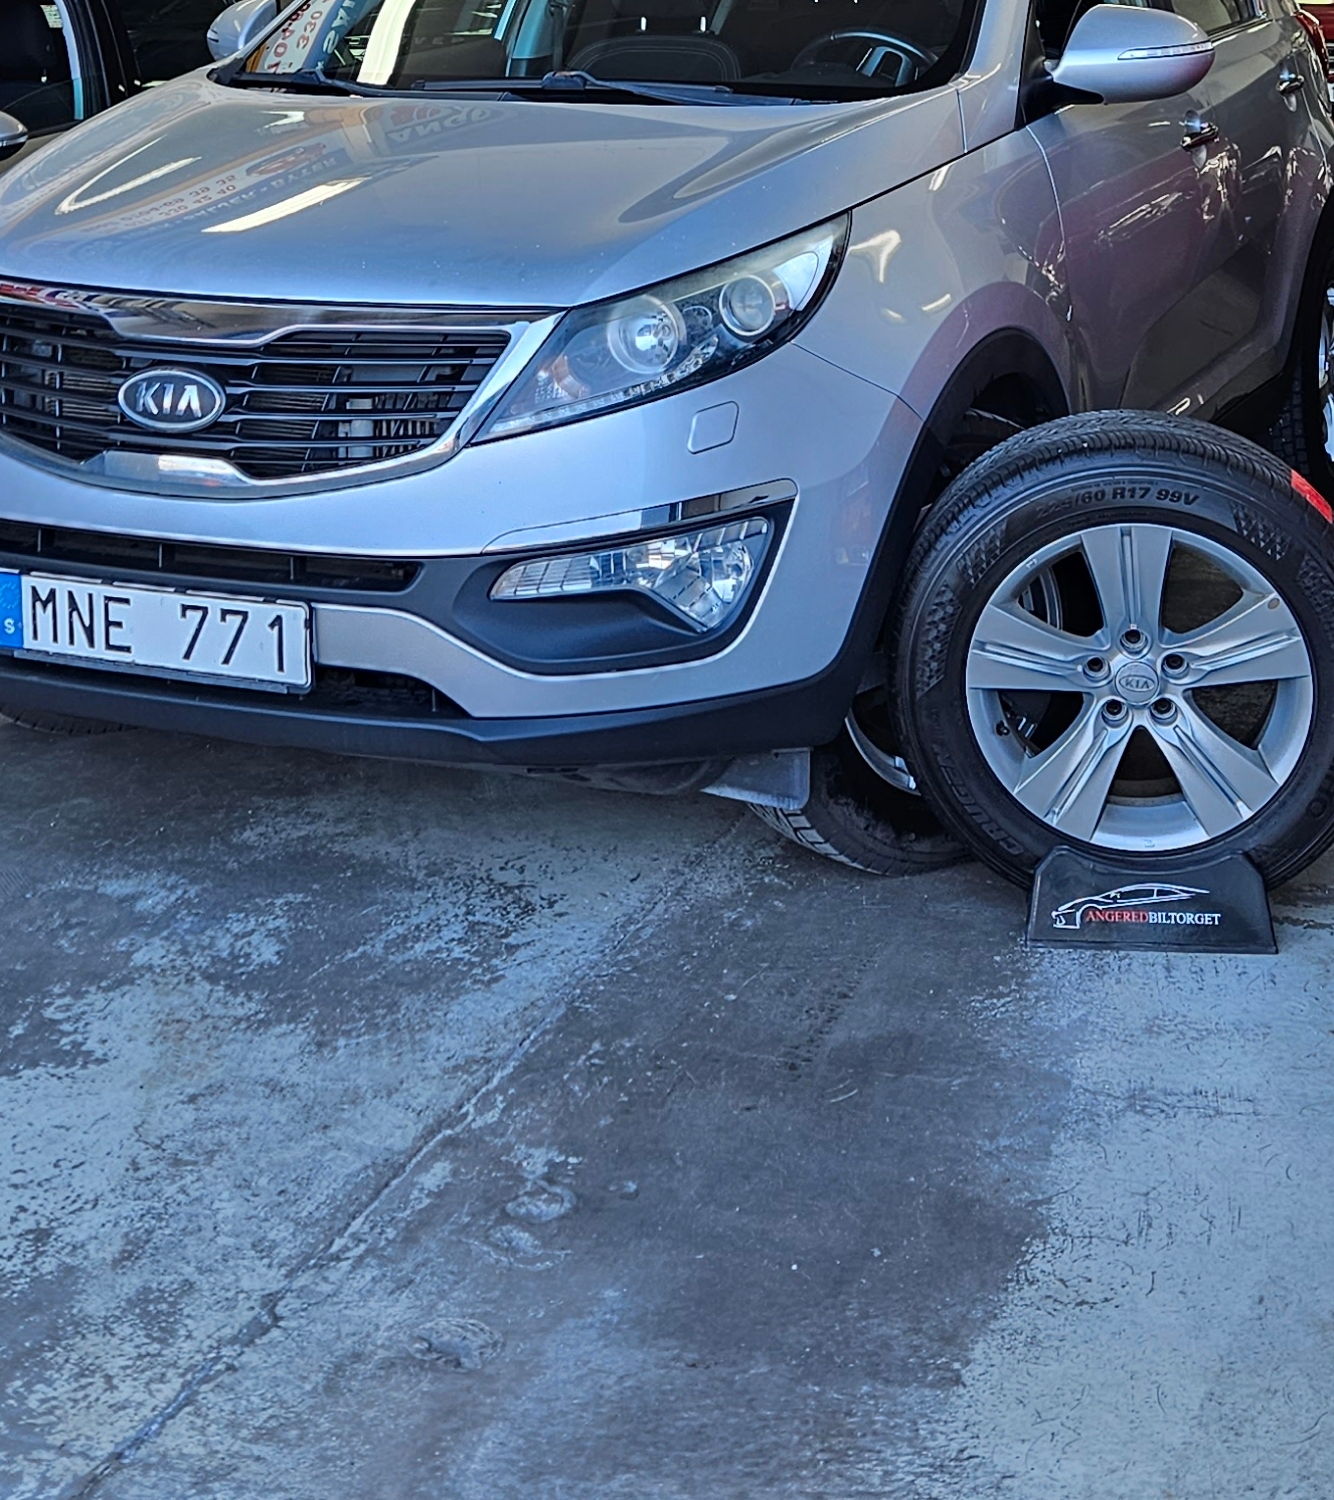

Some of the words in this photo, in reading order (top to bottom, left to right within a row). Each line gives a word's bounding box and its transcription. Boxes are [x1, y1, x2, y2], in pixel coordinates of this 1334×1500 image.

[134, 381, 202, 418] KIA
[1111, 486, 1152, 501] R17
[3, 617, 15, 634] S
[29, 585, 133, 654] MNE
[179, 603, 286, 674] 771
[1125, 678, 1150, 689] KIA
